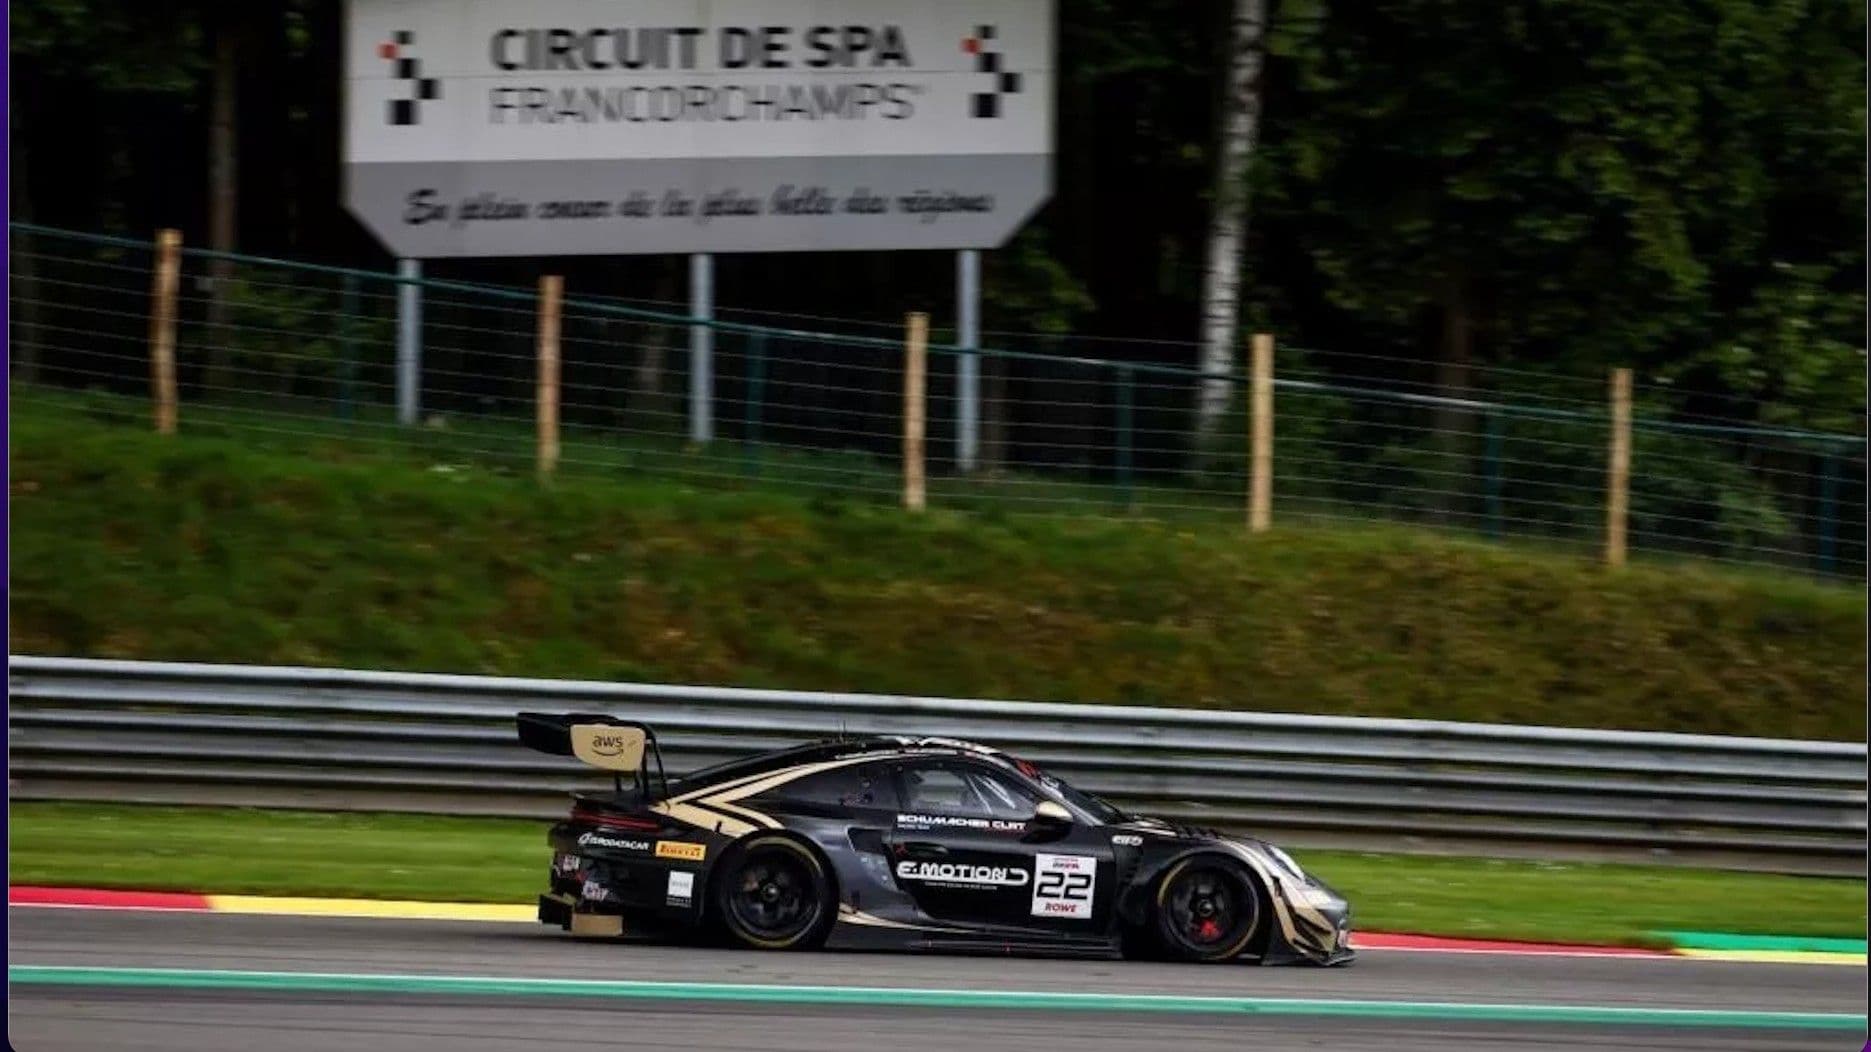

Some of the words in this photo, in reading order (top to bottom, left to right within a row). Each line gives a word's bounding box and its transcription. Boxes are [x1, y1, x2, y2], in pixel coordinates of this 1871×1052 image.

[490, 28, 705, 70] CIRCUIT
[720, 26, 791, 69] DE
[804, 25, 913, 67] SPA
[489, 82, 914, 123] FRANCORCHAMPS
[592, 735, 624, 748] aws
[897, 813, 990, 829] SCHUMACHER
[1037, 870, 1092, 900] 22
[1045, 902, 1078, 914] ROWE
